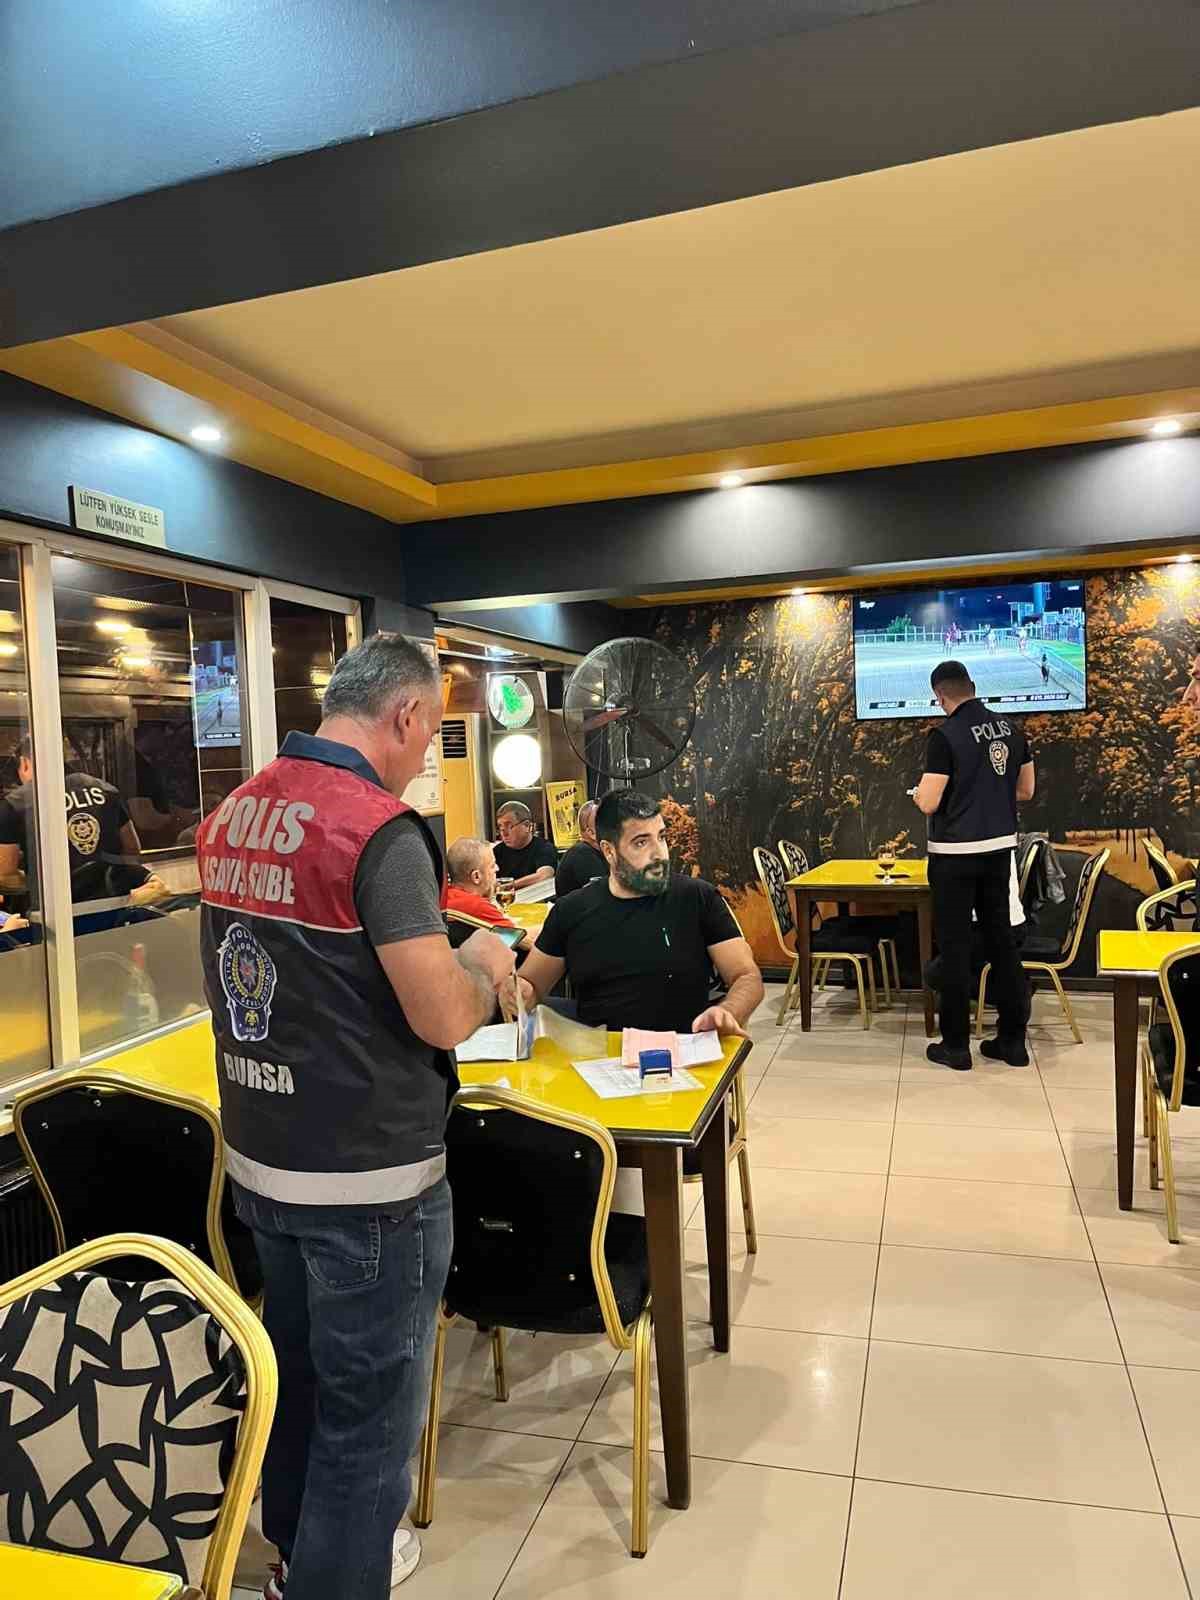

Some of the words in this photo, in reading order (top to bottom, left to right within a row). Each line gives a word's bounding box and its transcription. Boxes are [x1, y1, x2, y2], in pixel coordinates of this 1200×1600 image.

[79, 491, 107, 513] LÜTFEN
[64, 787, 106, 812] OLİS
[223, 1051, 297, 1096] BURSA
